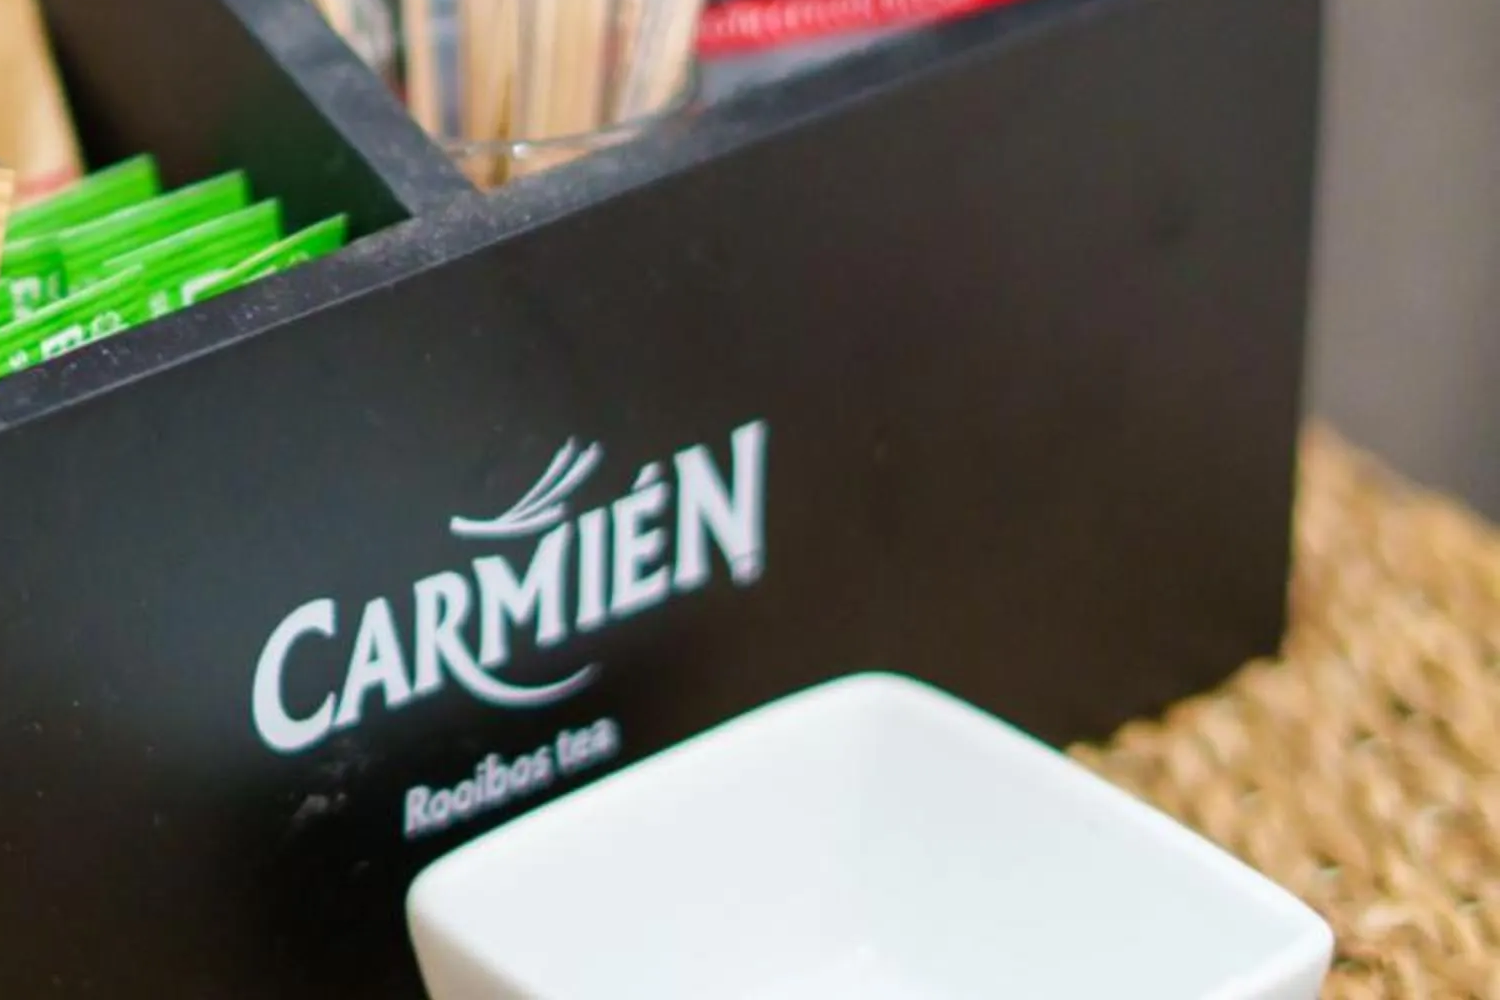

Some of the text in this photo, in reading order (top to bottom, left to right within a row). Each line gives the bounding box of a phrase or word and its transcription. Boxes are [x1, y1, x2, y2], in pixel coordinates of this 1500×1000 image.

[252, 418, 768, 755] CARMIÉN
[404, 714, 621, 837] Rooibos tea
